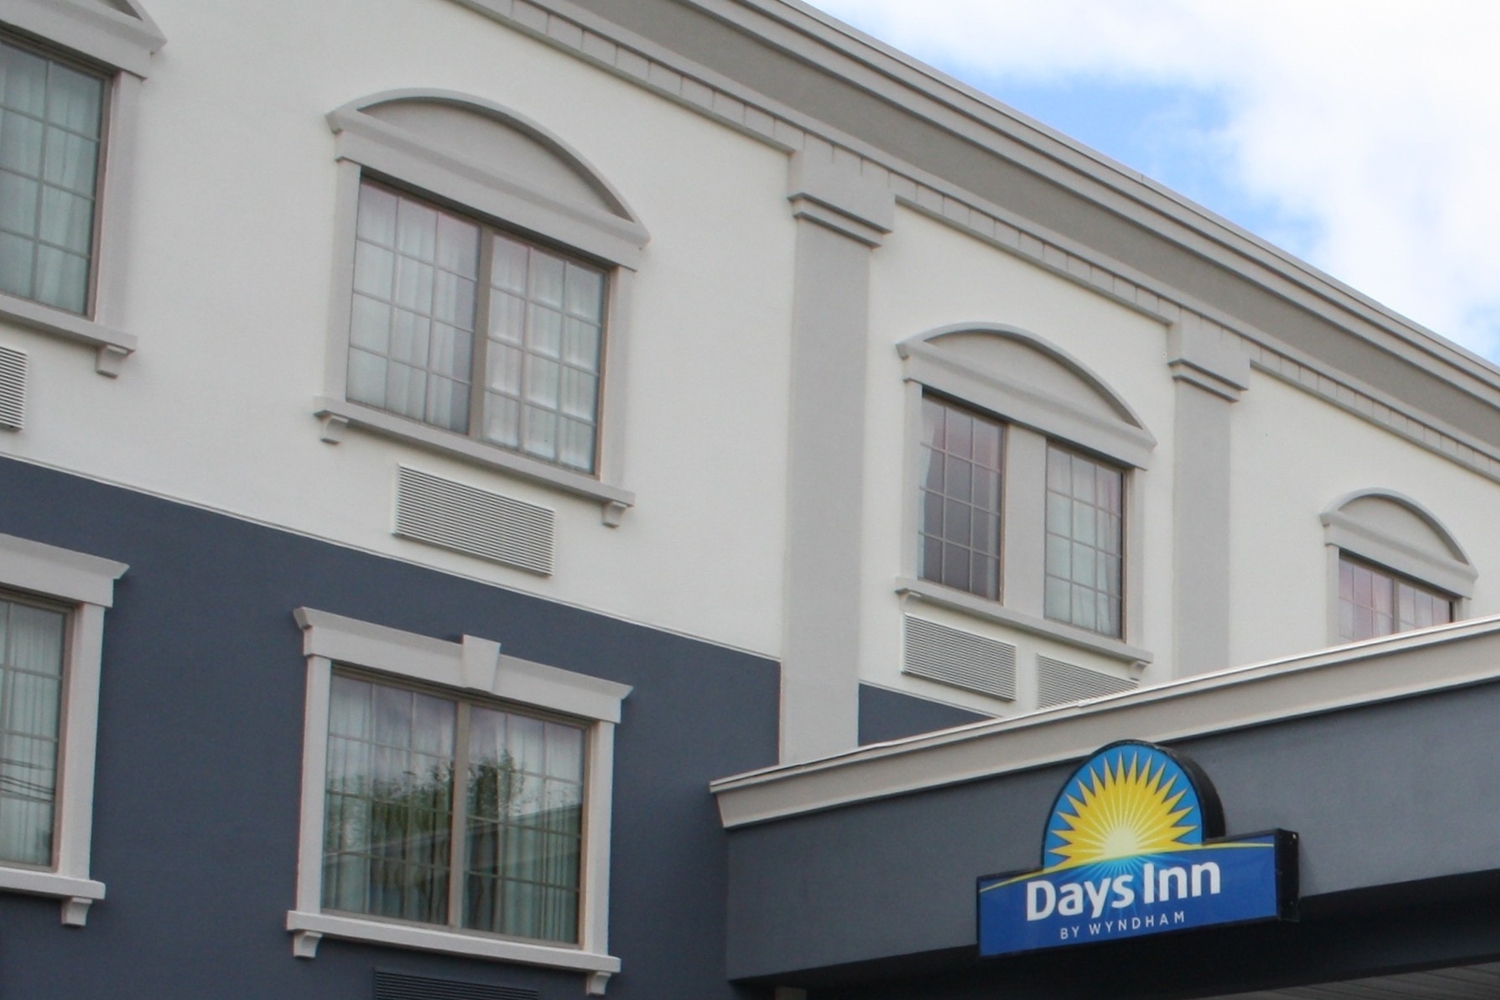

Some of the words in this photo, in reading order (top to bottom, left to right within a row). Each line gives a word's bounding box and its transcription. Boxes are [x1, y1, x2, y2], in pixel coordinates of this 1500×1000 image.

[1026, 874, 1135, 921] Days
[1143, 861, 1221, 904] Inn
[1060, 926, 1080, 940] BY
[1089, 911, 1185, 935] WYNDHAM
